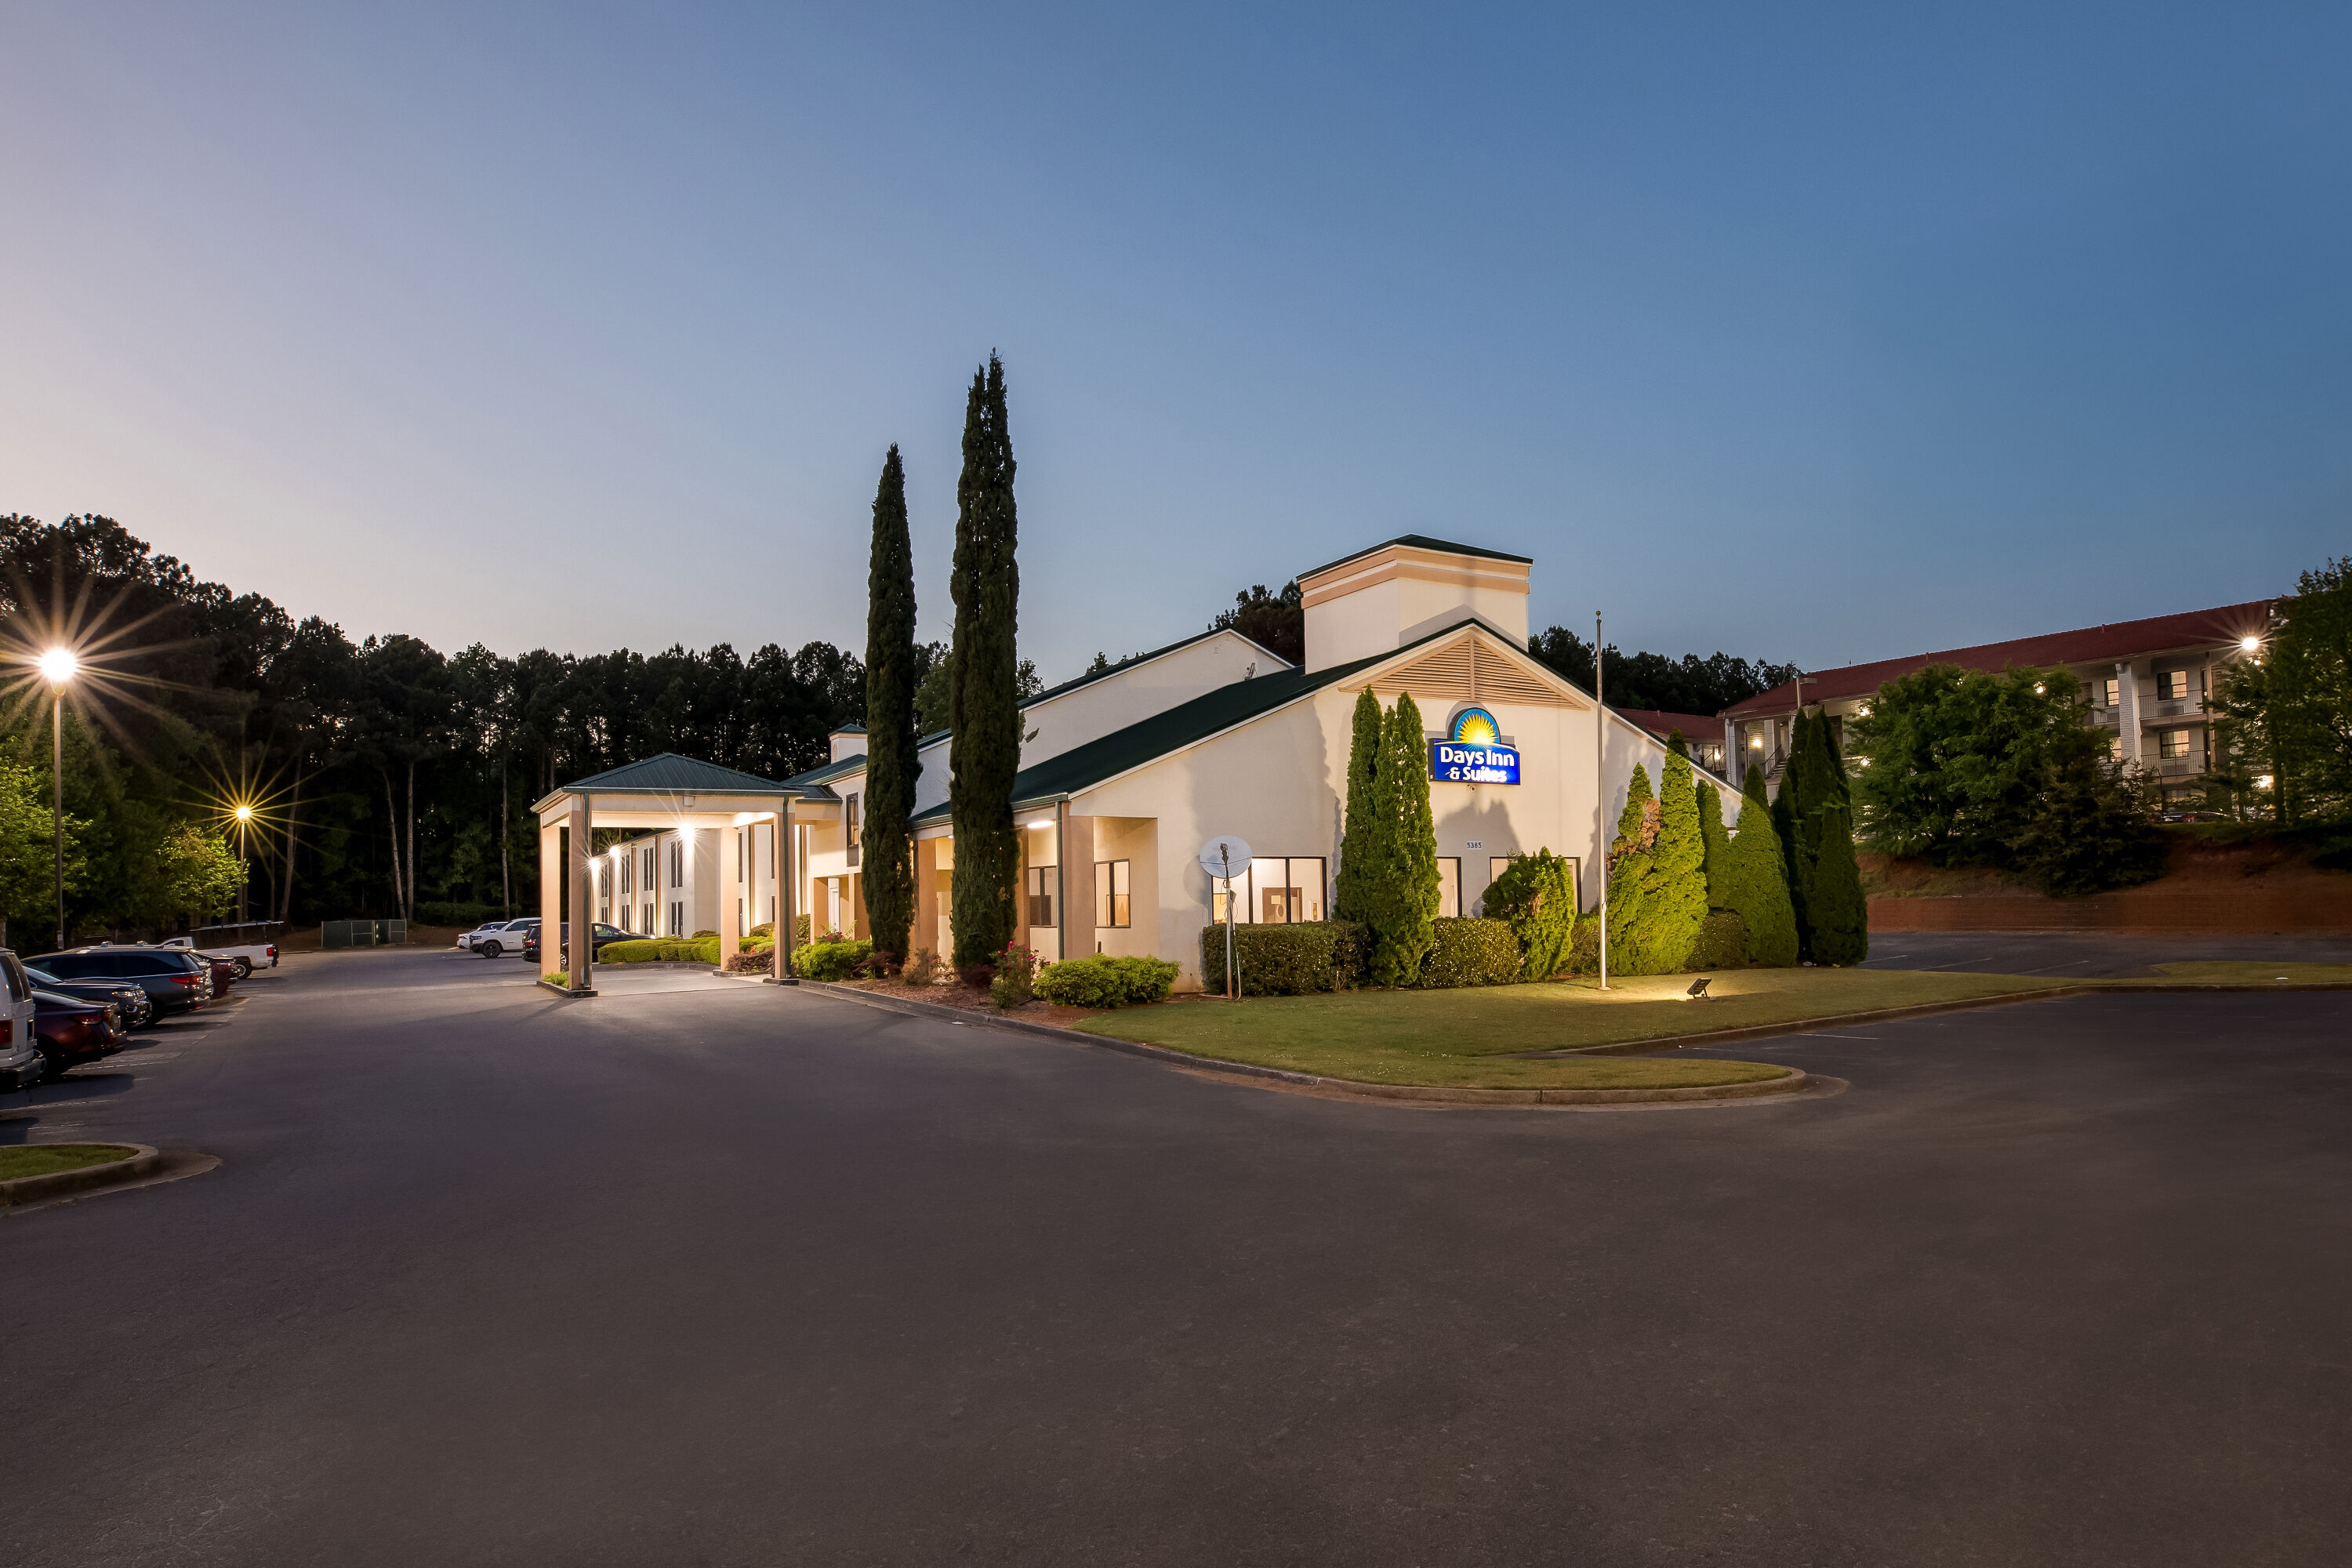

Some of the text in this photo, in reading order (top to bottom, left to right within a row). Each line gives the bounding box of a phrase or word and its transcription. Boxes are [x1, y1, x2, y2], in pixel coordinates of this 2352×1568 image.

[1440, 746, 1515, 767] Days Inn
[1450, 766, 1507, 782] & Suites
